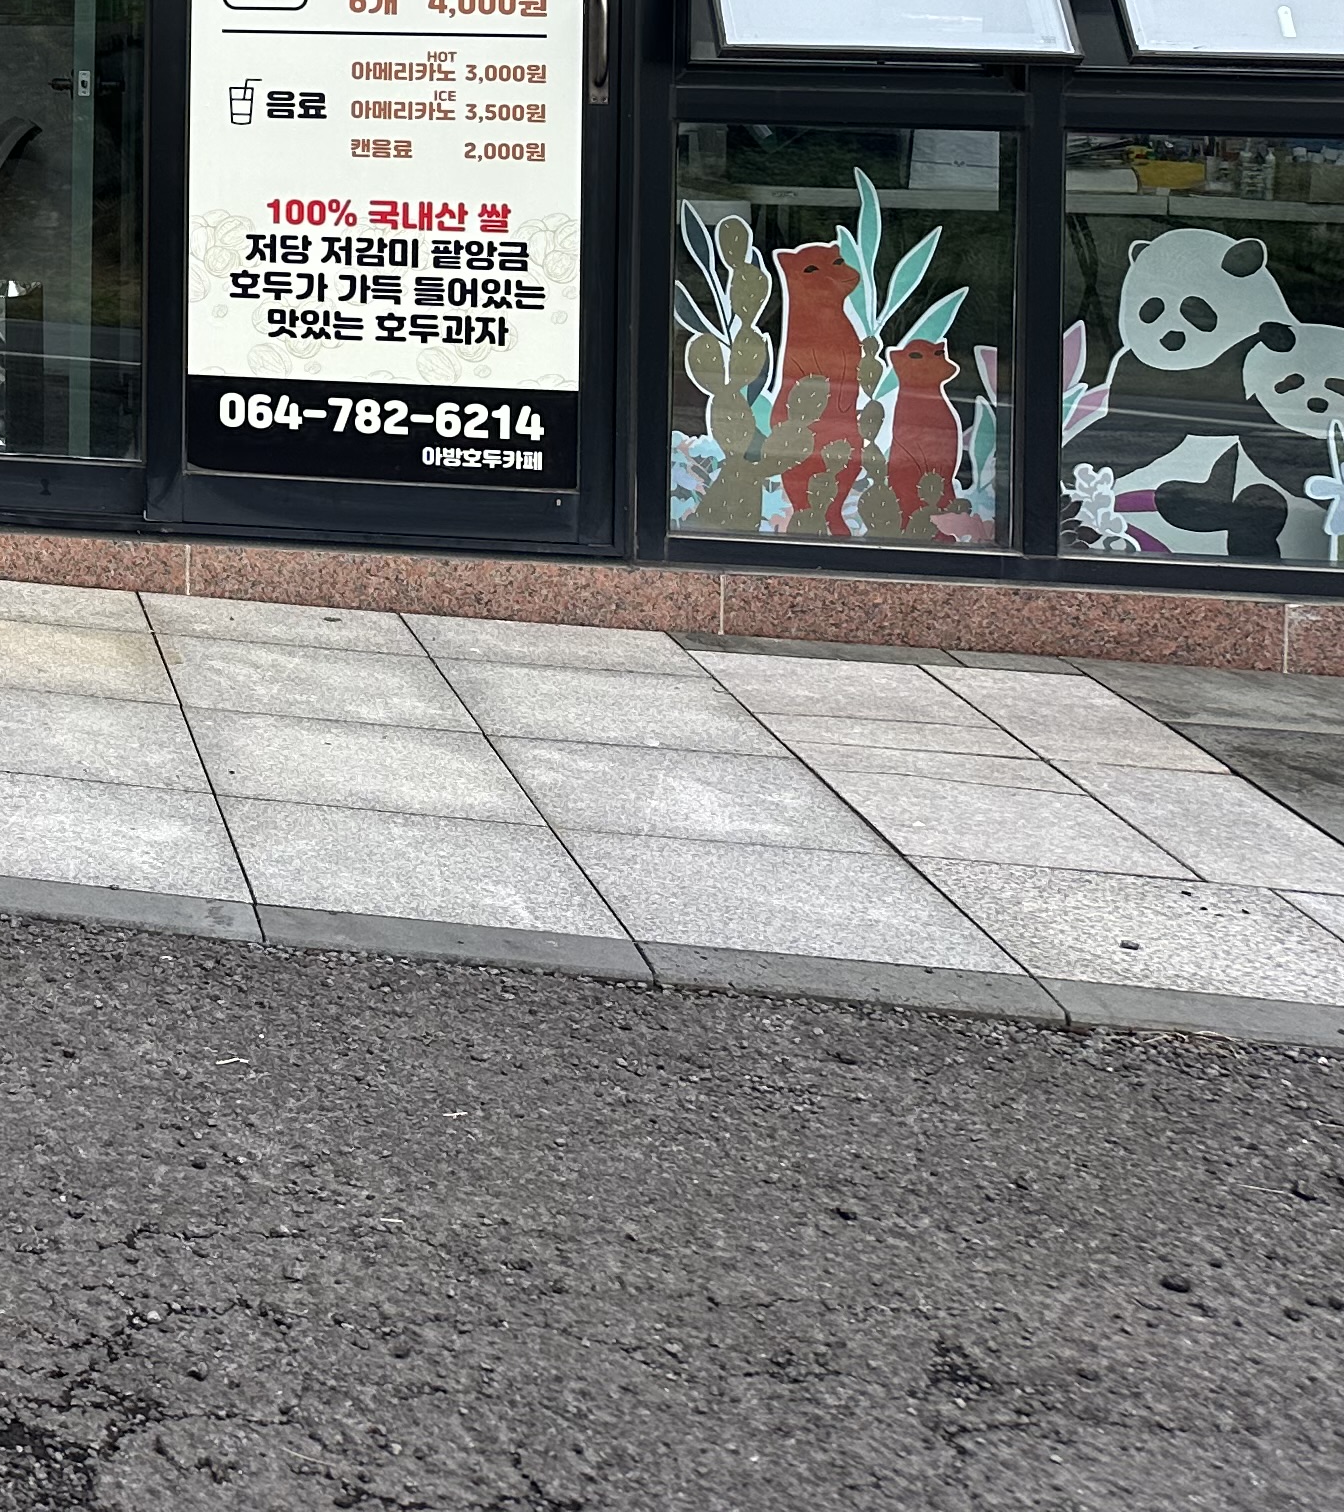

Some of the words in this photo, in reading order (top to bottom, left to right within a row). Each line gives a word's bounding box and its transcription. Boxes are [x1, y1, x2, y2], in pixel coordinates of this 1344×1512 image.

[427, 50, 458, 63] HOT
[351, 61, 457, 82] 아메리카노
[465, 64, 547, 85] 3,000원
[265, 90, 328, 120] 음료
[434, 90, 457, 102] ICE
[350, 100, 457, 121] 아메리카노
[464, 103, 547, 124] 3,500원
[350, 138, 413, 159] 캔음료
[464, 142, 546, 163] 2,000원
[266, 198, 358, 227] 100%
[367, 200, 469, 232] 국내산
[477, 203, 512, 233] 쌀
[245, 233, 313, 265] 저당
[320, 236, 419, 269] 저감미
[430, 239, 530, 272] 팥앙금
[229, 269, 329, 303] 호두가
[337, 273, 403, 306] 가득
[413, 276, 546, 310] 들어있는
[267, 308, 365, 341] 맛있는
[374, 312, 510, 347] 호두과자
[219, 392, 545, 441] 064-782-6214
[421, 446, 543, 471] 아방호두카페
